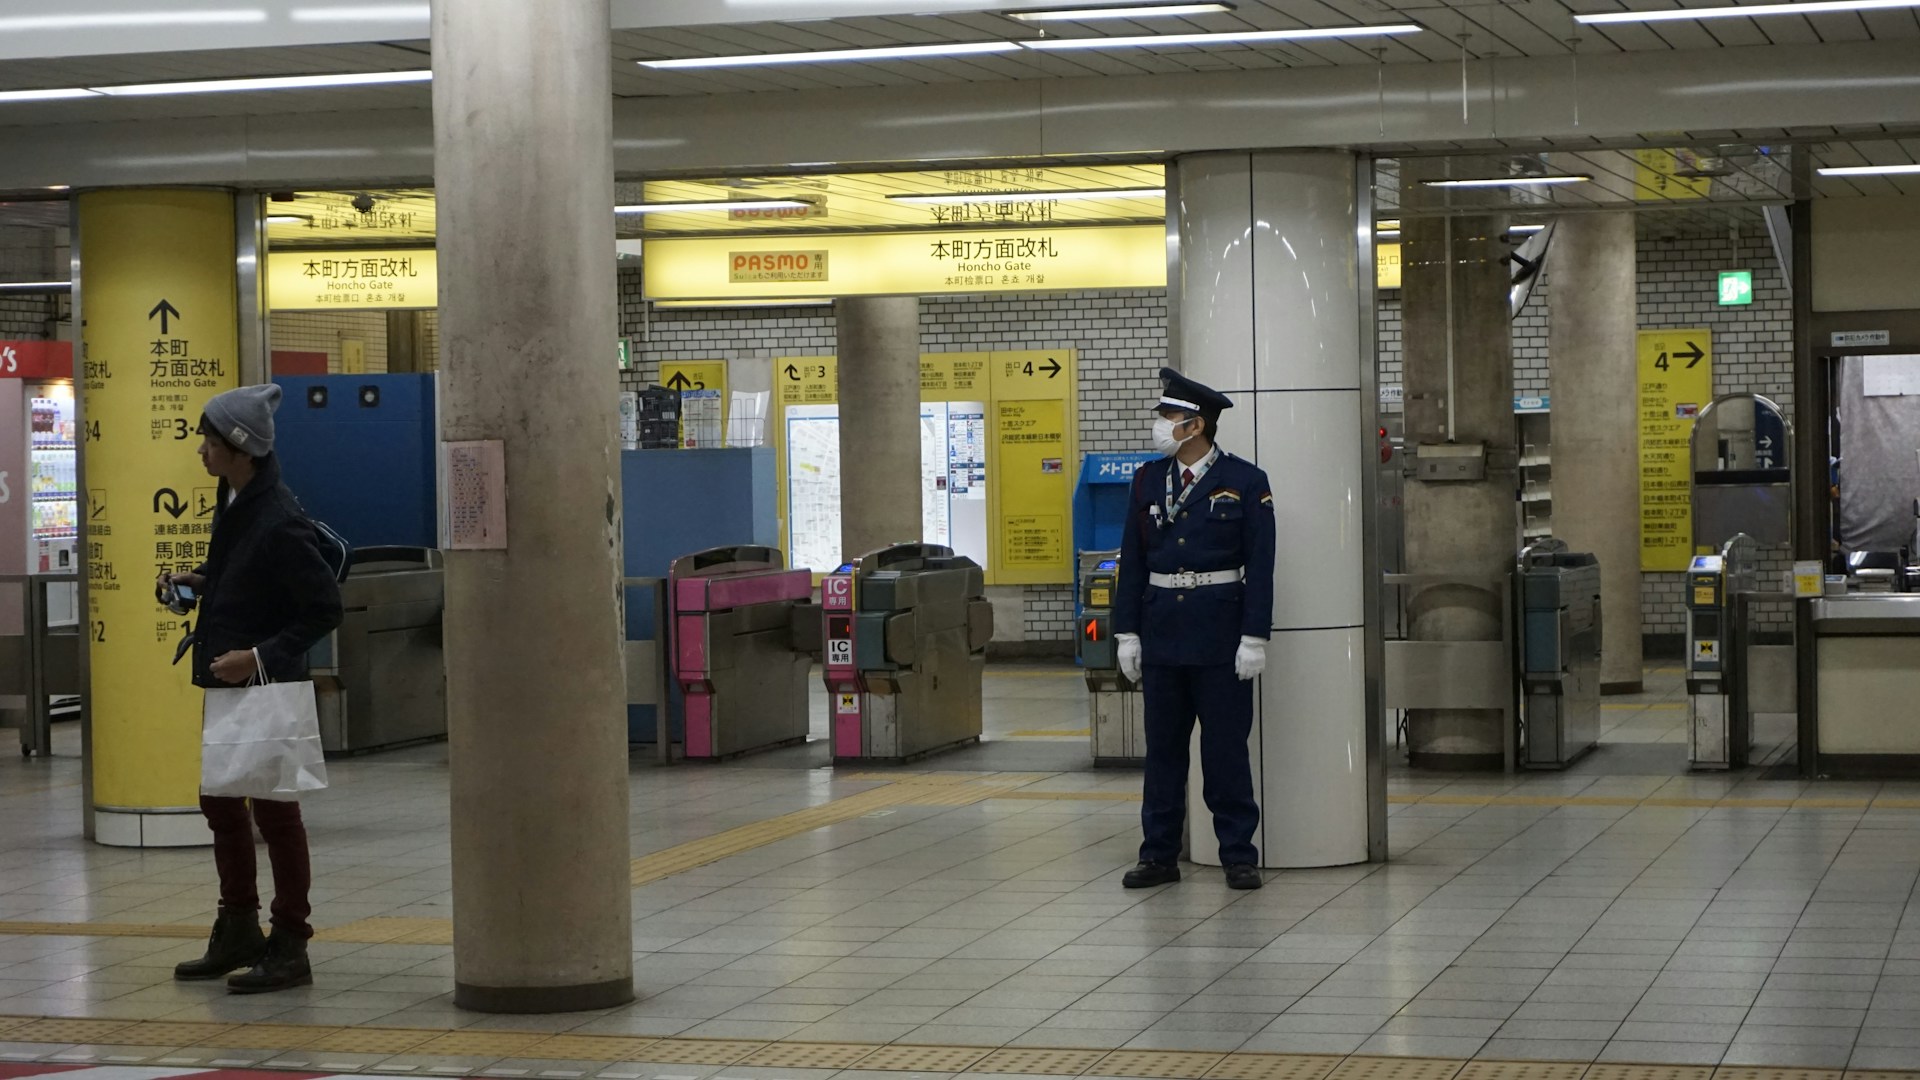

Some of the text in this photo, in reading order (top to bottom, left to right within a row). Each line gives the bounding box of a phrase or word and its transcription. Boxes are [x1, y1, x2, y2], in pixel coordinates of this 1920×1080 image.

[930, 237, 1058, 260] 本町方面改札
[734, 254, 809, 271] PASMO
[814, 253, 823, 270] 専用
[957, 260, 1032, 272] Honcho Gate
[1377, 255, 1399, 265] 出口
[303, 257, 417, 279] 本町方面改札
[327, 280, 393, 290] Honcho Gate
[150, 339, 189, 357] 本町
[150, 358, 225, 377] 方面改札
[1023, 361, 1034, 376] 4
[1655, 352, 1670, 371] 4
[818, 365, 826, 378] 3
[151, 379, 217, 388] Honcho Gate
[152, 419, 171, 428] 出口
[155, 540, 211, 560] 馬喰町
[827, 579, 847, 595] IC
[156, 621, 176, 632] 出口
[832, 641, 848, 652] IC
[832, 654, 849, 662] 専用
